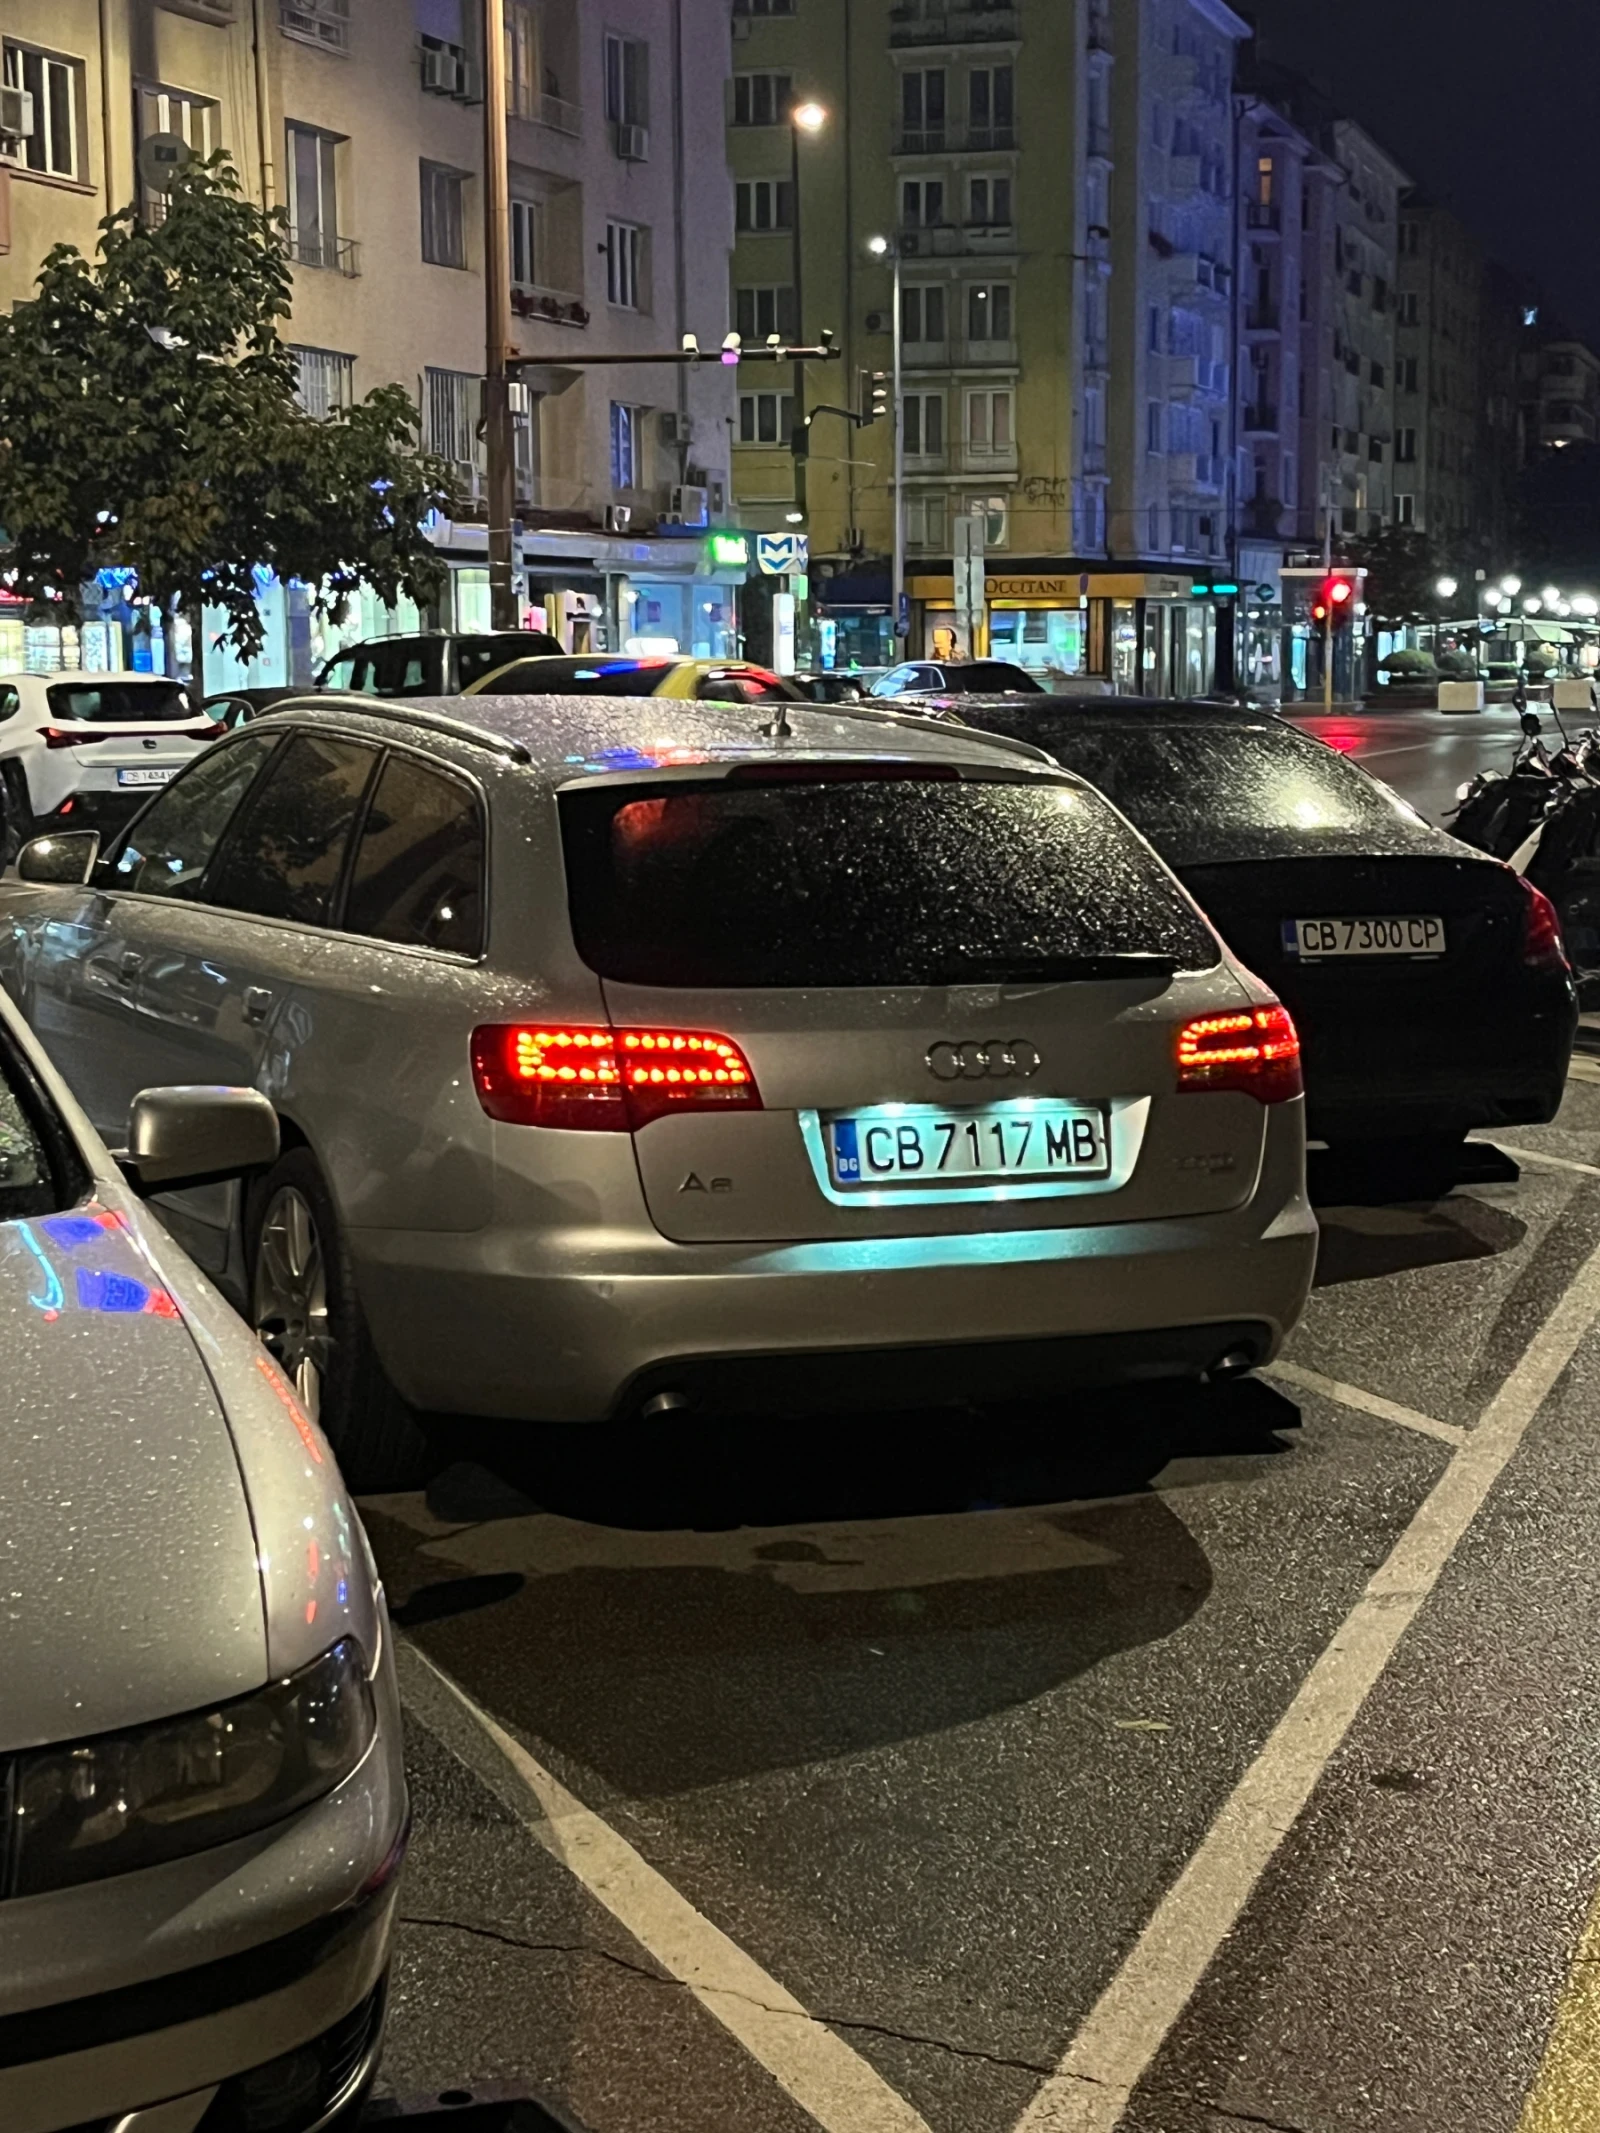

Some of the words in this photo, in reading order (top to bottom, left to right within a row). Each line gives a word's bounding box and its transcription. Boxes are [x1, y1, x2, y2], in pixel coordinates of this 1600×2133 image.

[1302, 922, 1337, 951] CB
[1341, 920, 1403, 951] 7300
[1408, 919, 1439, 949] CP
[865, 1126, 924, 1173] CB
[934, 1120, 1033, 1170] 7117
[1045, 1118, 1097, 1167] MB
[838, 1157, 858, 1173] BG
